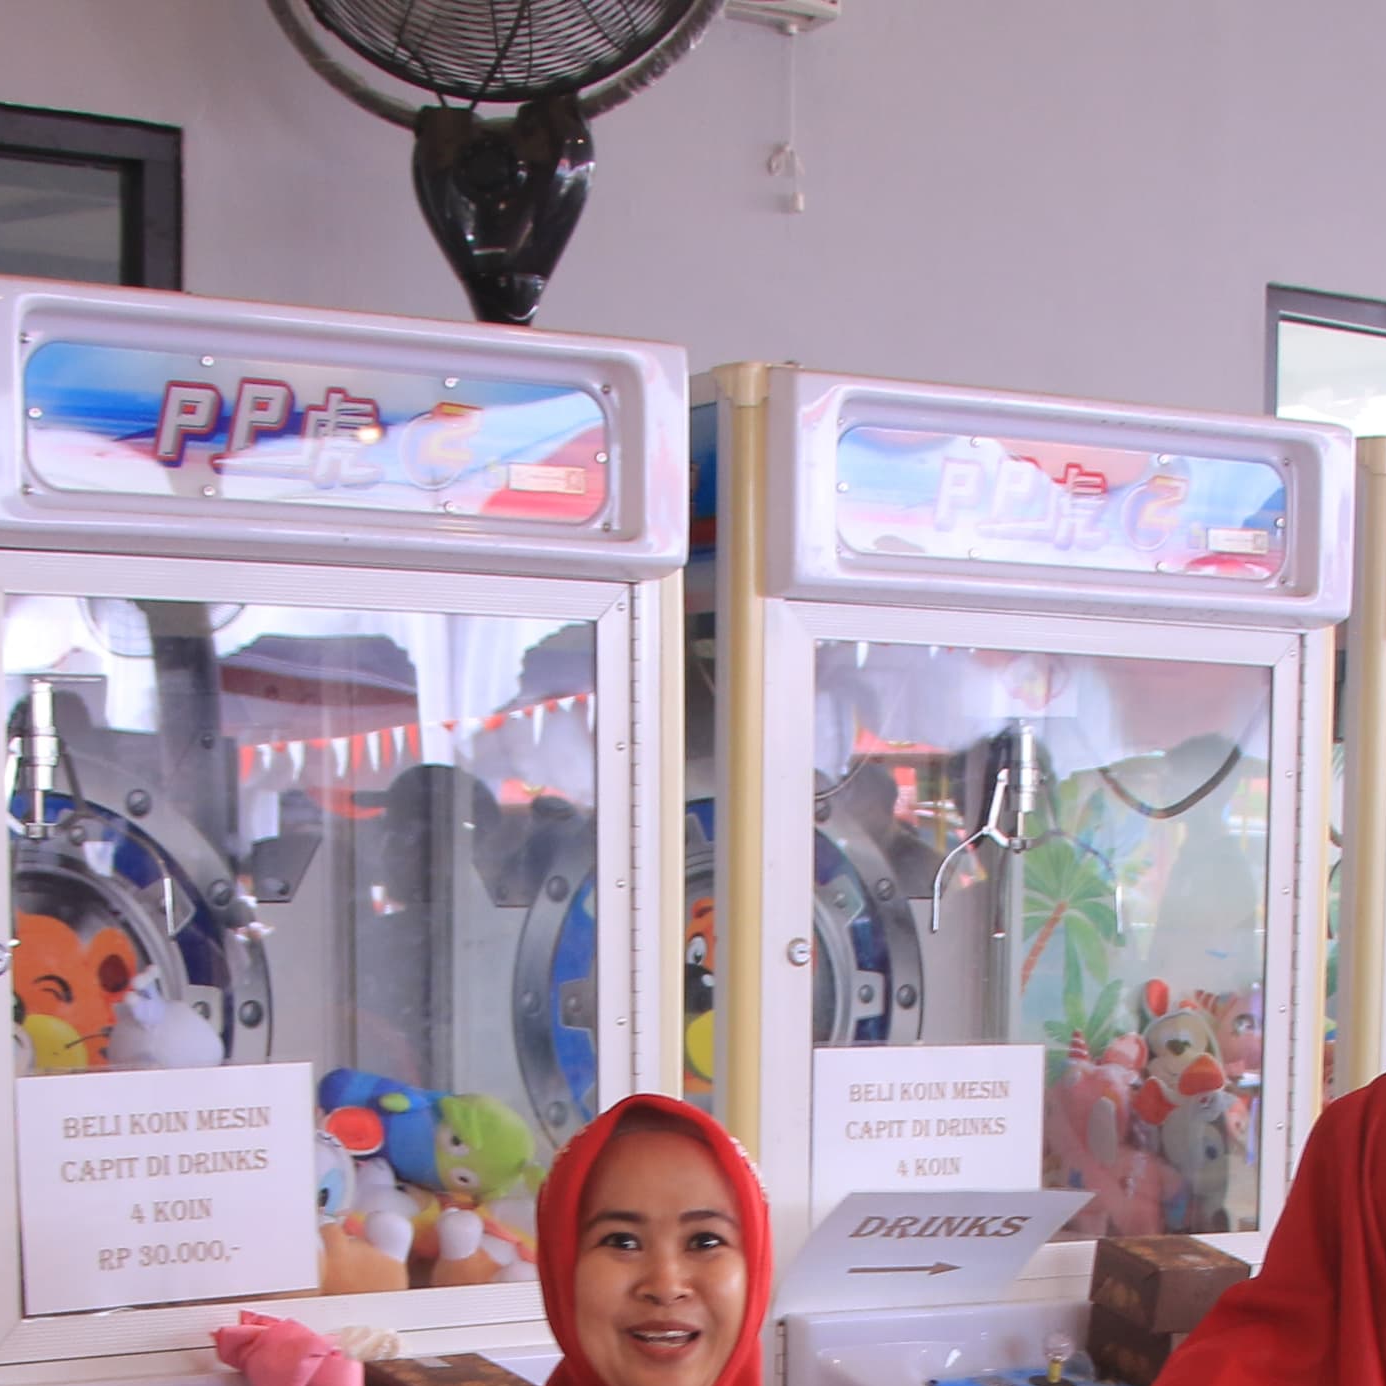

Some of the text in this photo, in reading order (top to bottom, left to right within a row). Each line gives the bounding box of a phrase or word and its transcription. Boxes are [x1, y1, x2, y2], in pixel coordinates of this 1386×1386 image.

[849, 1080, 1011, 1103] BELI KOIN MESIN
[62, 1106, 271, 1139] BELI KOIN MESIN
[845, 1116, 1006, 1140] CAPIT DI DRINKS
[61, 1149, 269, 1183] CAPIT DI DRINKS
[896, 1157, 962, 1177] 4 KOIN
[130, 1198, 213, 1224] 4 KOIN
[849, 1215, 1032, 1239] DRINKS
[98, 1240, 241, 1271] RP 30.000,-
